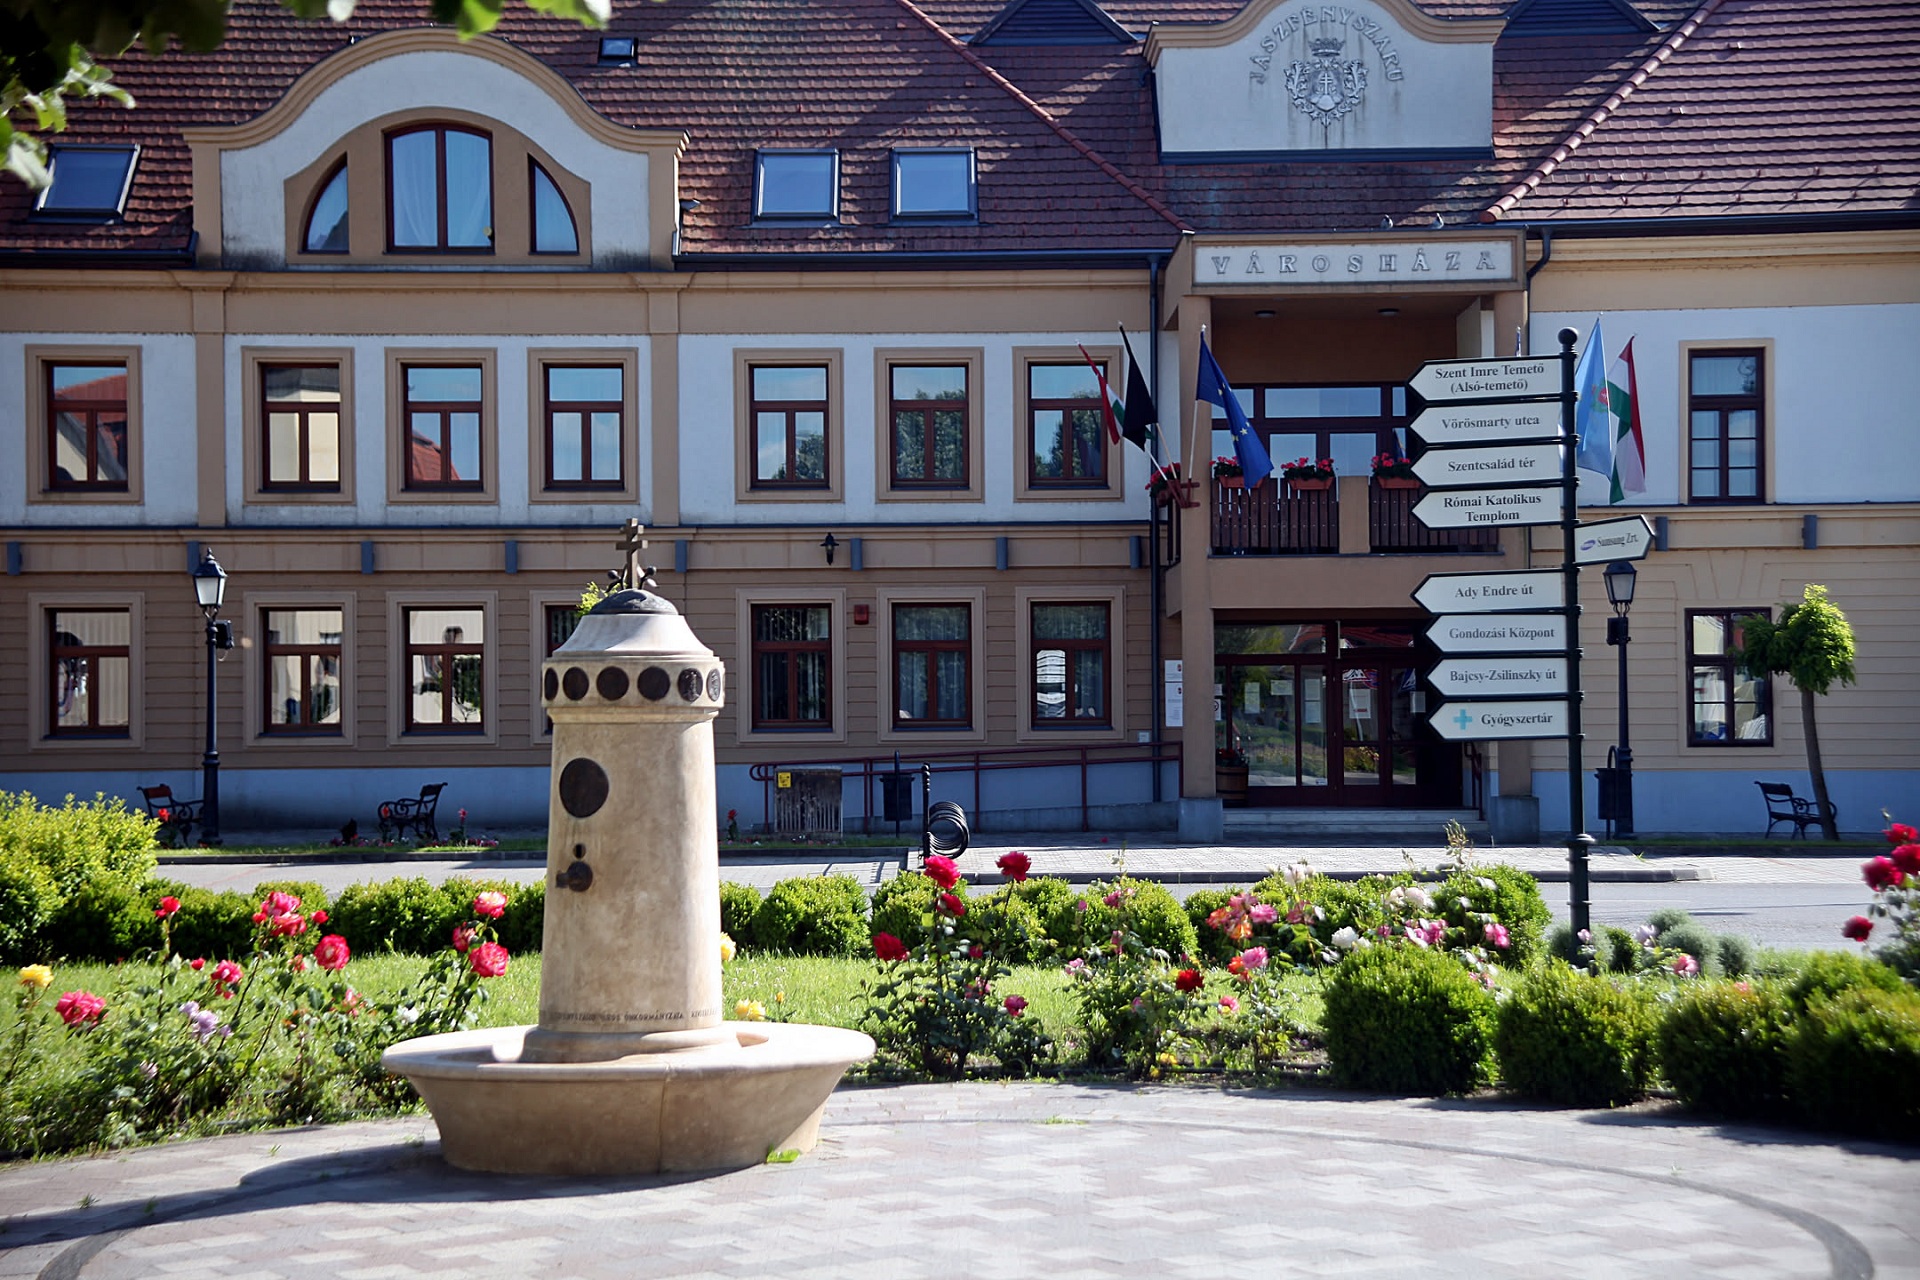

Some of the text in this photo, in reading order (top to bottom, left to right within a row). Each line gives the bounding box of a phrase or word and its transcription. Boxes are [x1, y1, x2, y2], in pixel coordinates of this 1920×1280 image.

[1211, 249, 1495, 274] VÁROSHÁZA
[1435, 363, 1544, 379] Szent Imre Temető
[1450, 379, 1528, 395] (Alsó-temető)
[1441, 416, 1540, 429] Vörösmarty utca
[1448, 457, 1535, 472] Szentcsalád tér
[1444, 494, 1541, 508] Római Katolikus
[1465, 511, 1520, 524] Templom
[1454, 584, 1533, 600] Ady Endre út
[1449, 627, 1555, 641] Gondozási Központ
[1450, 669, 1556, 684] Bajcsy-Zsilinszky út
[1481, 713, 1553, 727] Gyógyszertár
